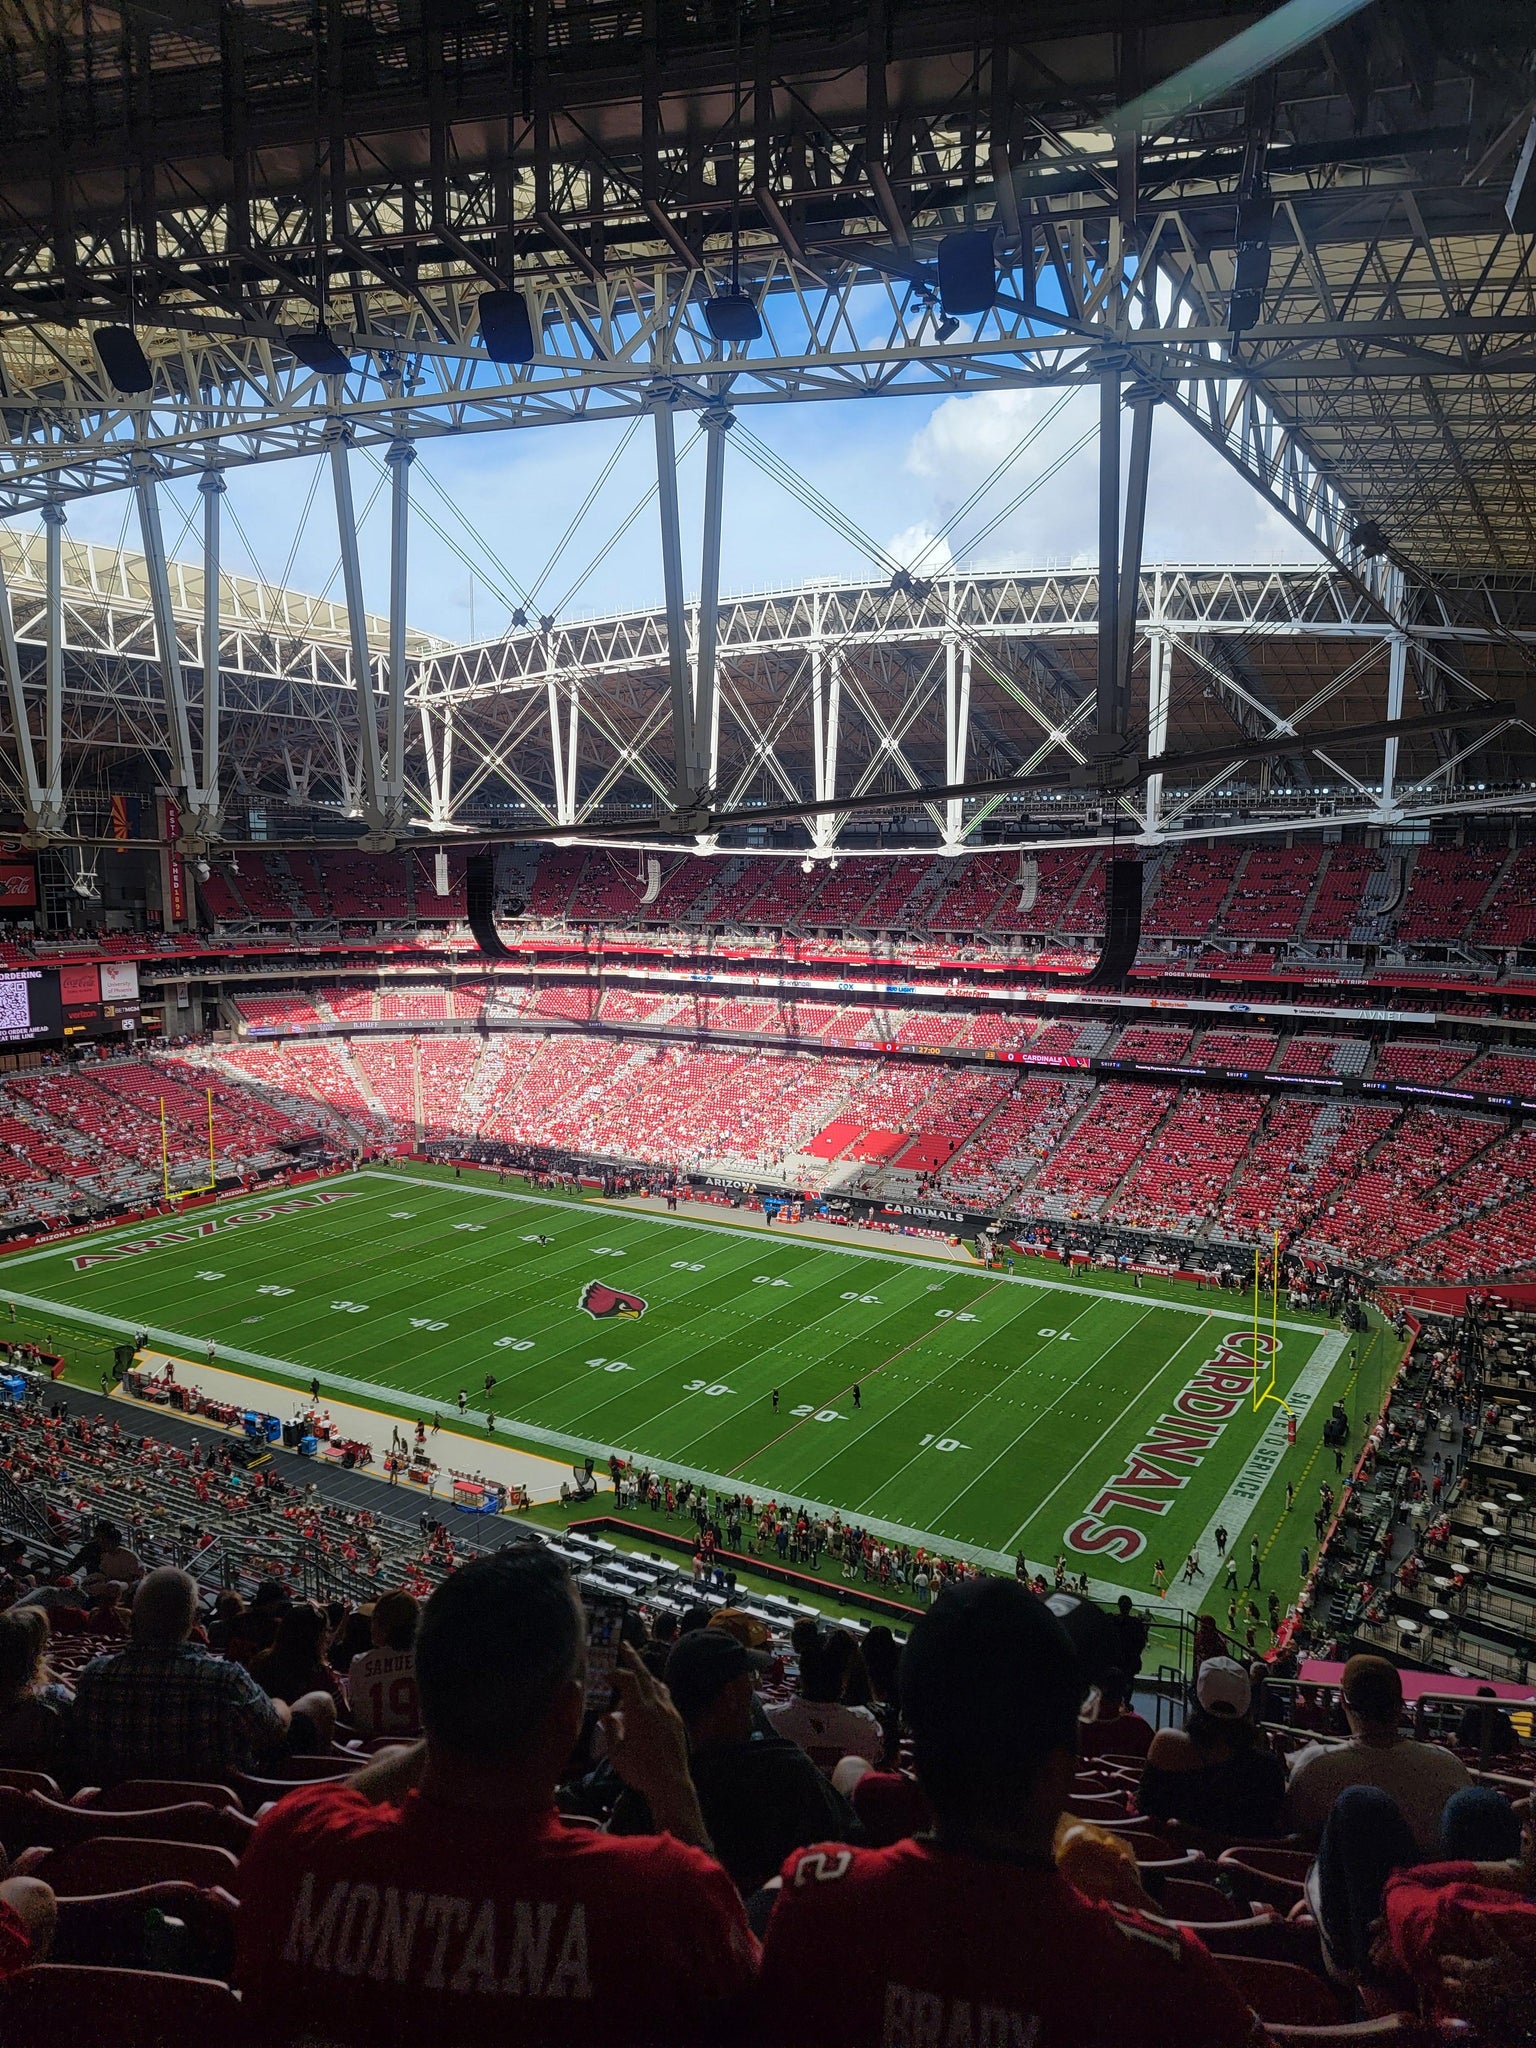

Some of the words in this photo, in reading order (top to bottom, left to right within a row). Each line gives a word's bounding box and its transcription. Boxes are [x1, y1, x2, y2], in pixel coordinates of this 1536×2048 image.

[0, 971, 42, 980] ORDERING
[956, 989, 973, 997] State
[973, 990, 990, 998] Farm
[1358, 1010, 1404, 1020] AVNET
[918, 1046, 941, 1054] 27:00
[1022, 1053, 1063, 1063] CARDINALS
[220, 1187, 249, 1199] ARIZONA
[705, 1177, 758, 1192] ARIZONA
[884, 1203, 964, 1222] CARDINALS
[34, 1231, 71, 1244] ARIZONA
[73, 1219, 117, 1234] CARINALS
[64, 1191, 364, 1271] ARIZONA
[670, 1260, 706, 1272] 50
[1126, 1265, 1168, 1276] CARDINALS
[256, 1284, 295, 1297] 20
[839, 1291, 880, 1304] 30
[330, 1300, 370, 1313] 30
[934, 1309, 977, 1322] 20
[409, 1317, 449, 1331] 40
[493, 1336, 536, 1351] 50
[585, 1357, 629, 1373] 40
[683, 1379, 729, 1396] 30
[789, 1404, 839, 1423] 20
[918, 1433, 961, 1452] 10
[1063, 1331, 1283, 1563] CARDINALS
[1231, 1448, 1280, 1500] SERVICE
[369, 1677, 419, 1730] 19
[280, 1871, 594, 1999] MONTANA
